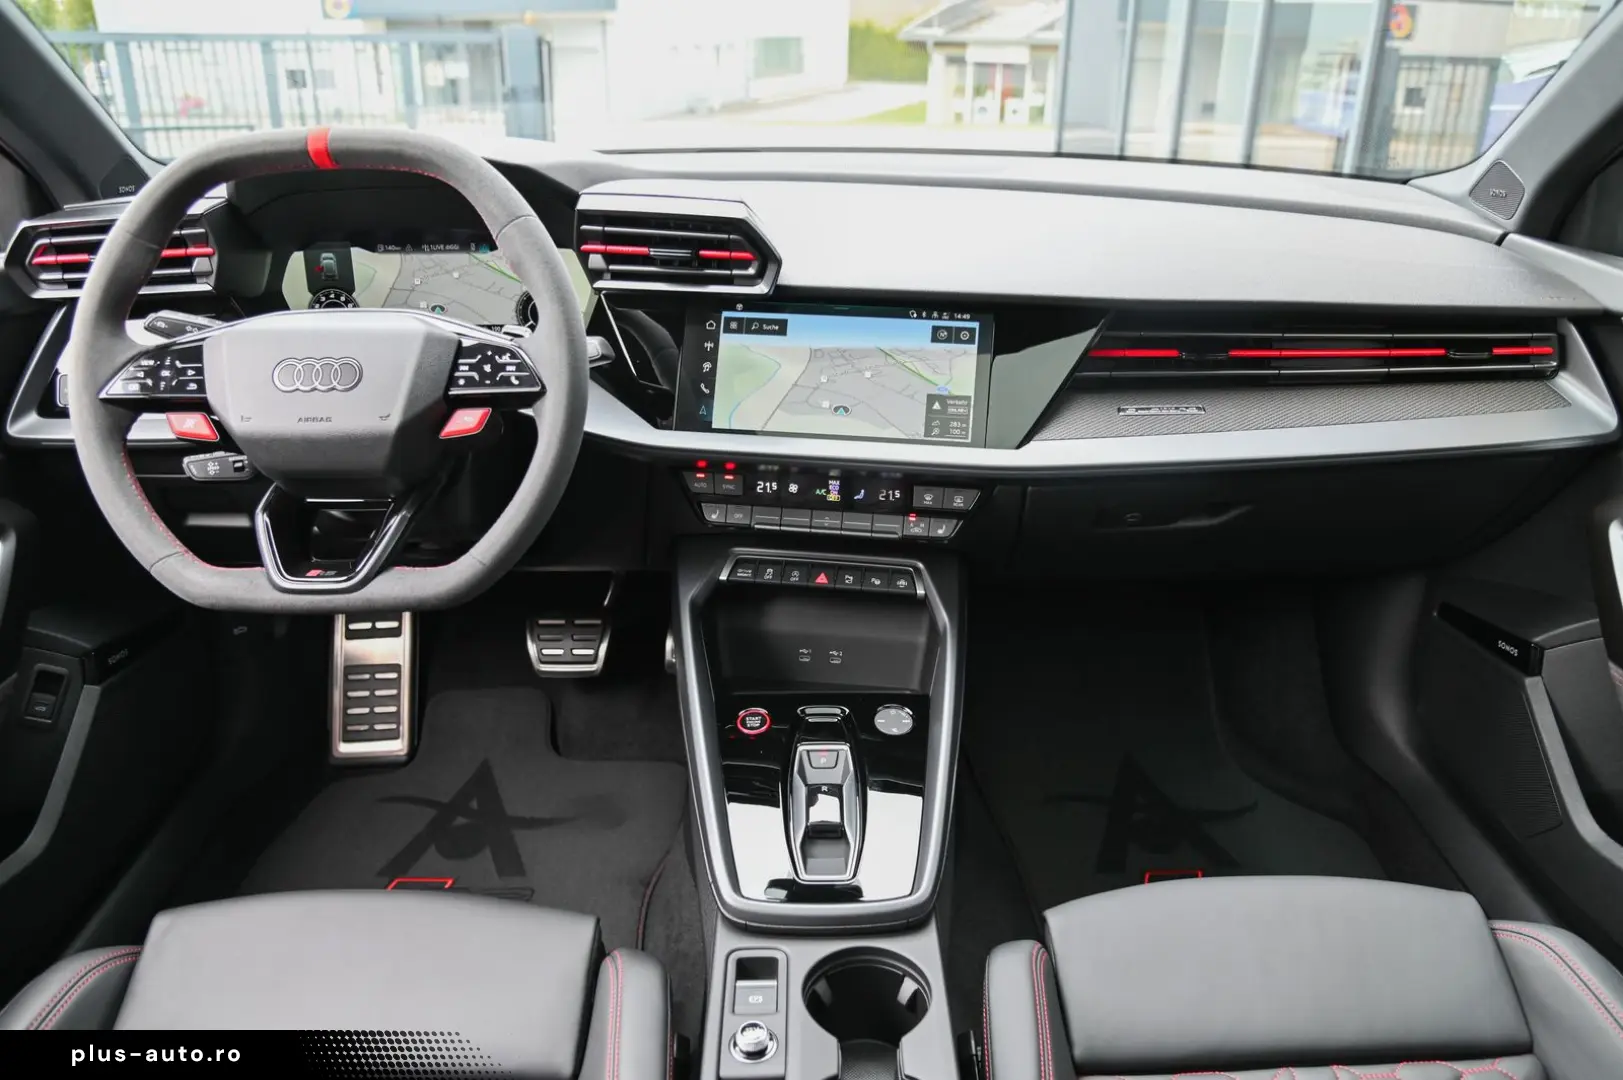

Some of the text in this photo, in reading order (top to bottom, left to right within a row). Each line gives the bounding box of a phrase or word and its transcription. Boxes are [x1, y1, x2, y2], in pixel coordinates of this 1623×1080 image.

[297, 416, 332, 424] AIRBAG
[1498, 640, 1519, 657] SONOS
[821, 785, 828, 793] R
